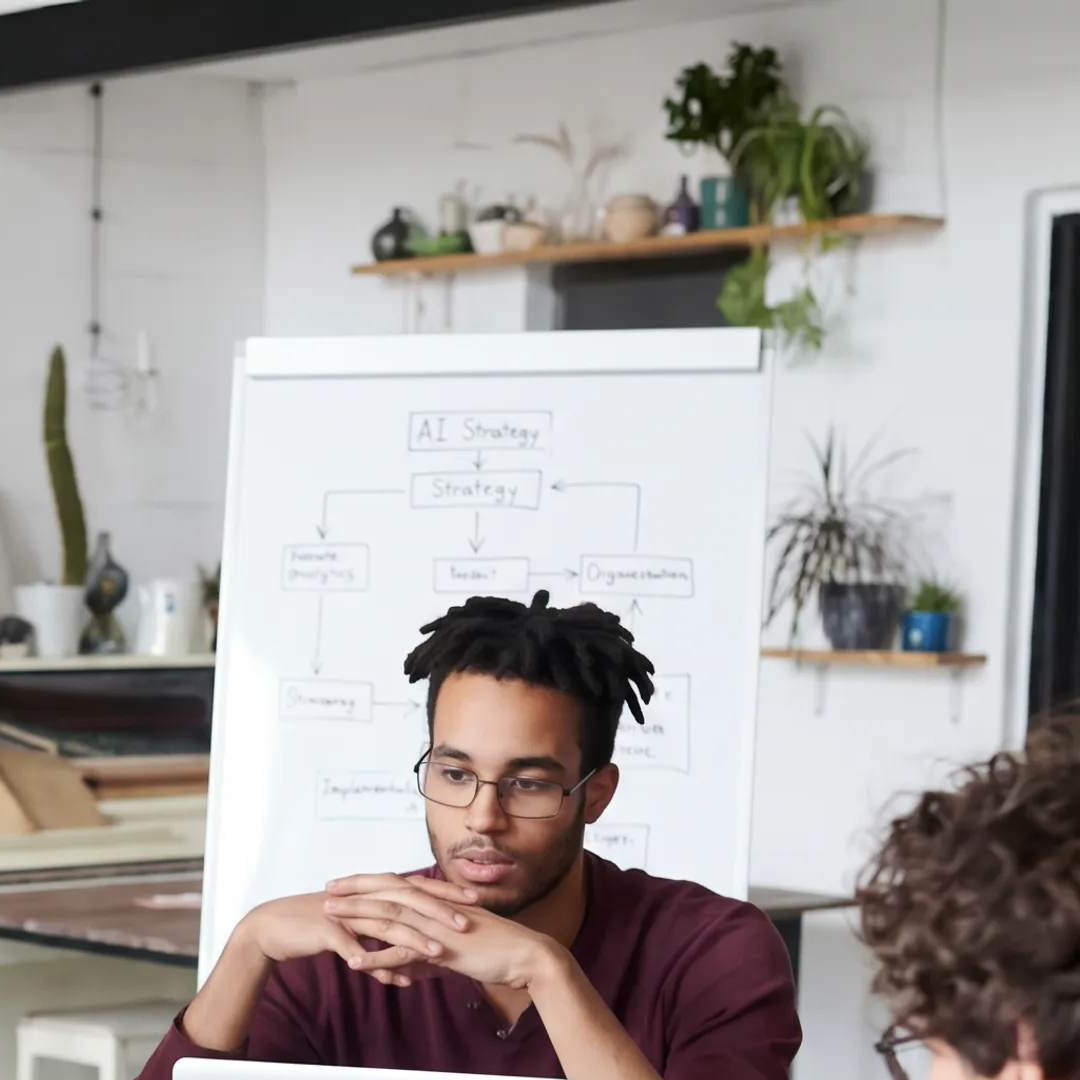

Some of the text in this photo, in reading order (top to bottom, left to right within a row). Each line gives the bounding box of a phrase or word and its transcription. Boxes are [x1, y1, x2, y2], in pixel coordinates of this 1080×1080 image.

[417, 417, 540, 448] AI Strategy
[431, 477, 519, 505] Strategy
